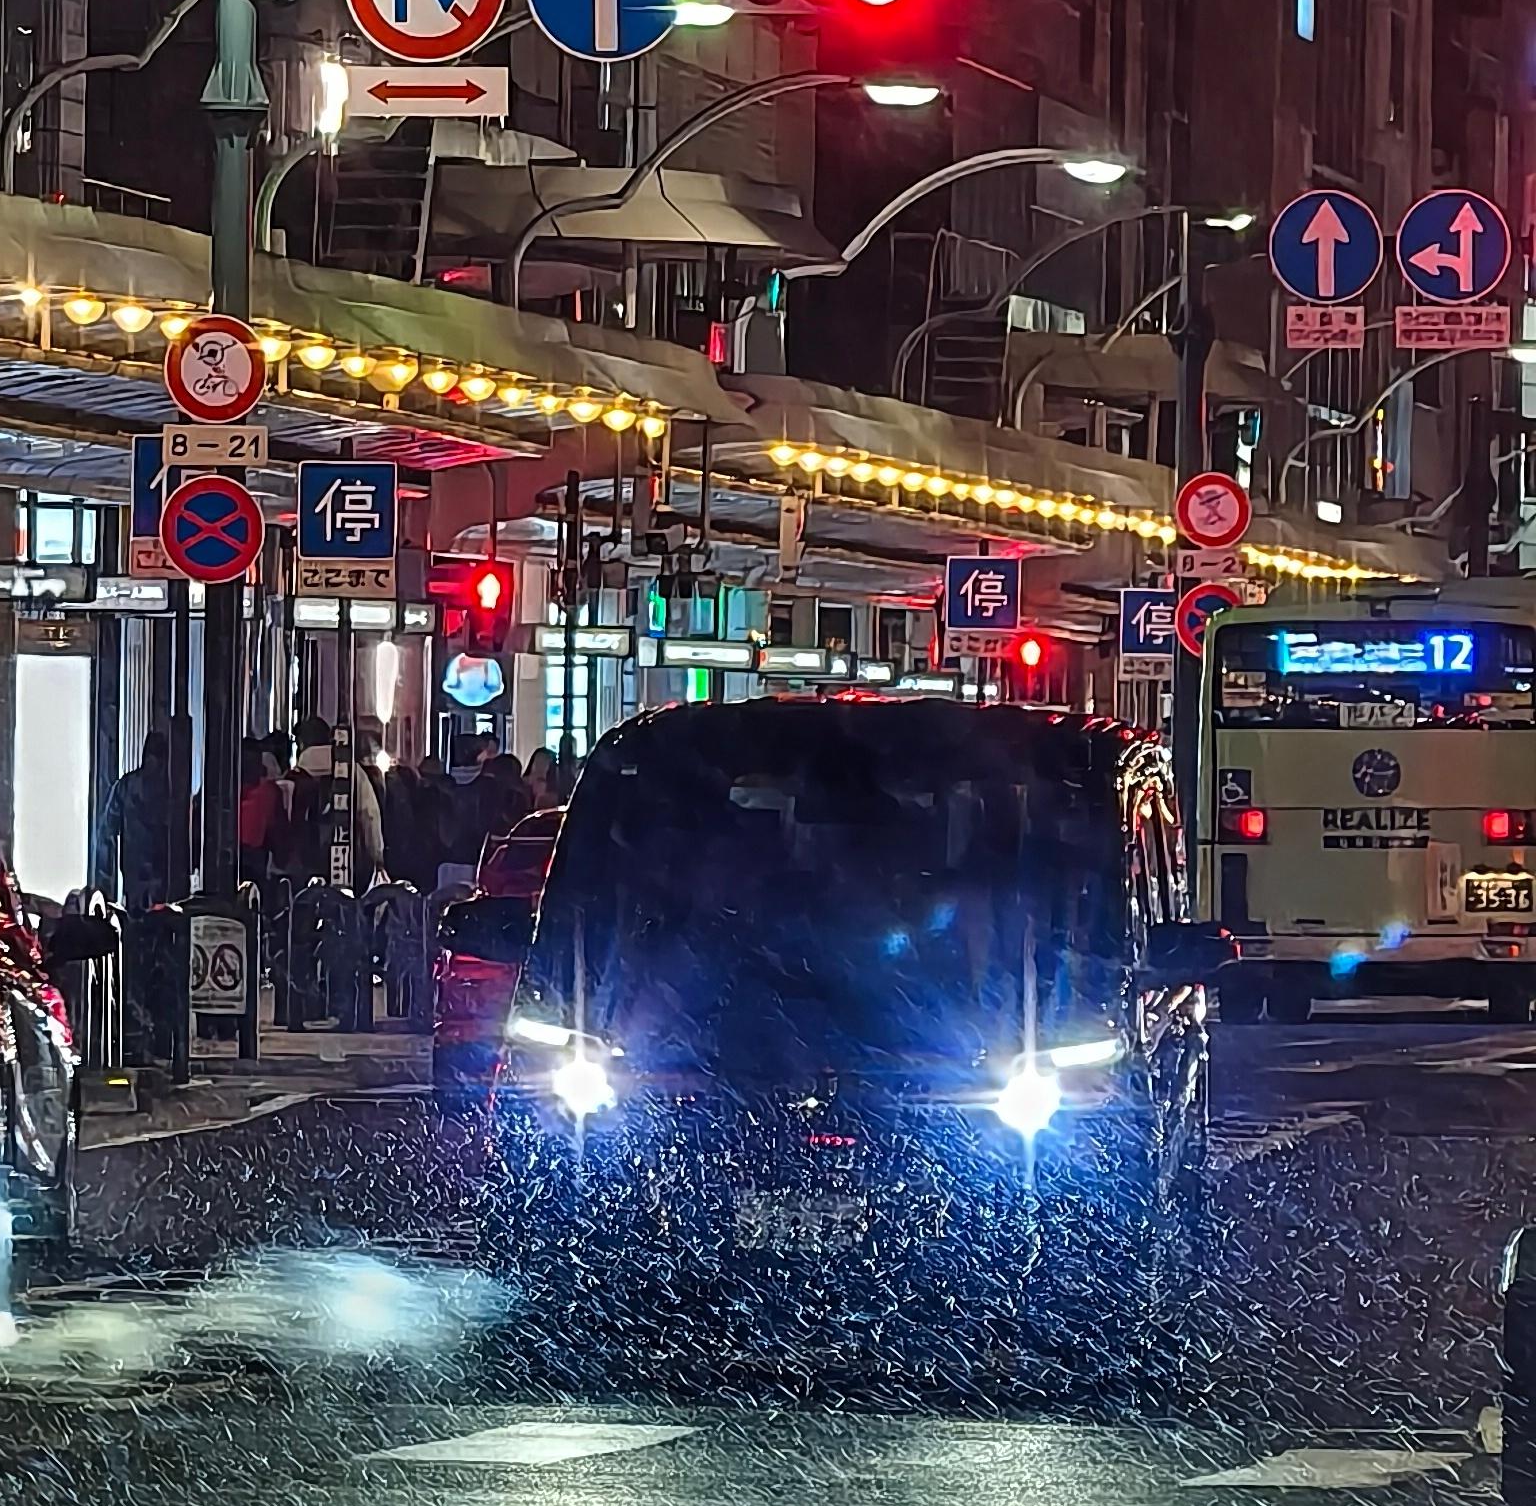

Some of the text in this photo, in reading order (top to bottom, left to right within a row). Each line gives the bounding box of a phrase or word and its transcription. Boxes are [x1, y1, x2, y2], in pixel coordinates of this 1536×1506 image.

[314, 478, 381, 543] 停
[302, 567, 391, 589] ここまで
[959, 568, 1009, 618] 停
[1130, 599, 1175, 645] 停
[1429, 634, 1473, 670] 12
[1322, 807, 1431, 830] REALIZE
